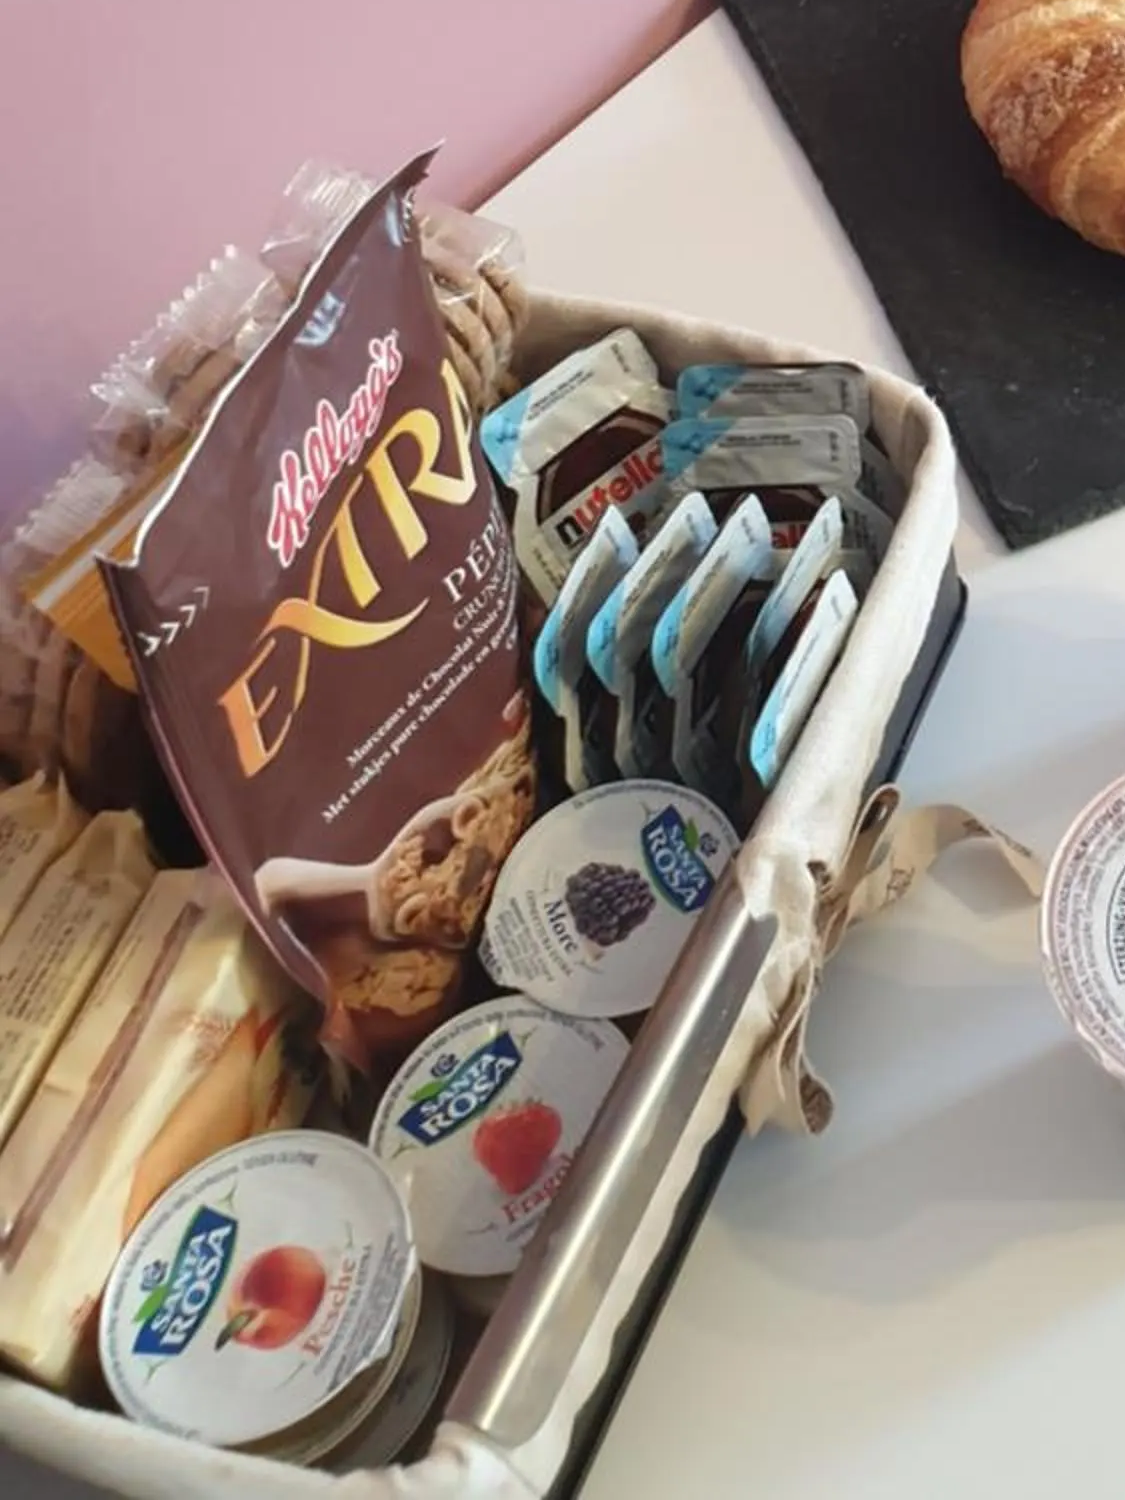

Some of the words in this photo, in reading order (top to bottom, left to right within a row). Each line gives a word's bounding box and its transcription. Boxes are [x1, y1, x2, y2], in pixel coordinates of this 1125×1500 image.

[267, 334, 402, 568] Kellogg's
[217, 358, 478, 778] EXTRA
[320, 792, 351, 822] Met
[345, 749, 395, 797] stukjes
[387, 719, 421, 752] pure
[414, 659, 480, 722] chocolade
[344, 705, 409, 767] Morceaux
[404, 687, 423, 705] de
[419, 635, 477, 690] Chocolat
[646, 824, 699, 909] ROSA
[668, 822, 708, 890] SANTA
[543, 899, 579, 953] More
[418, 1057, 516, 1137] ROSA
[421, 1054, 496, 1116] SANTA
[503, 1150, 574, 1225] Fragol
[151, 1233, 207, 1333] SANTA
[159, 1224, 234, 1347] ROSA
